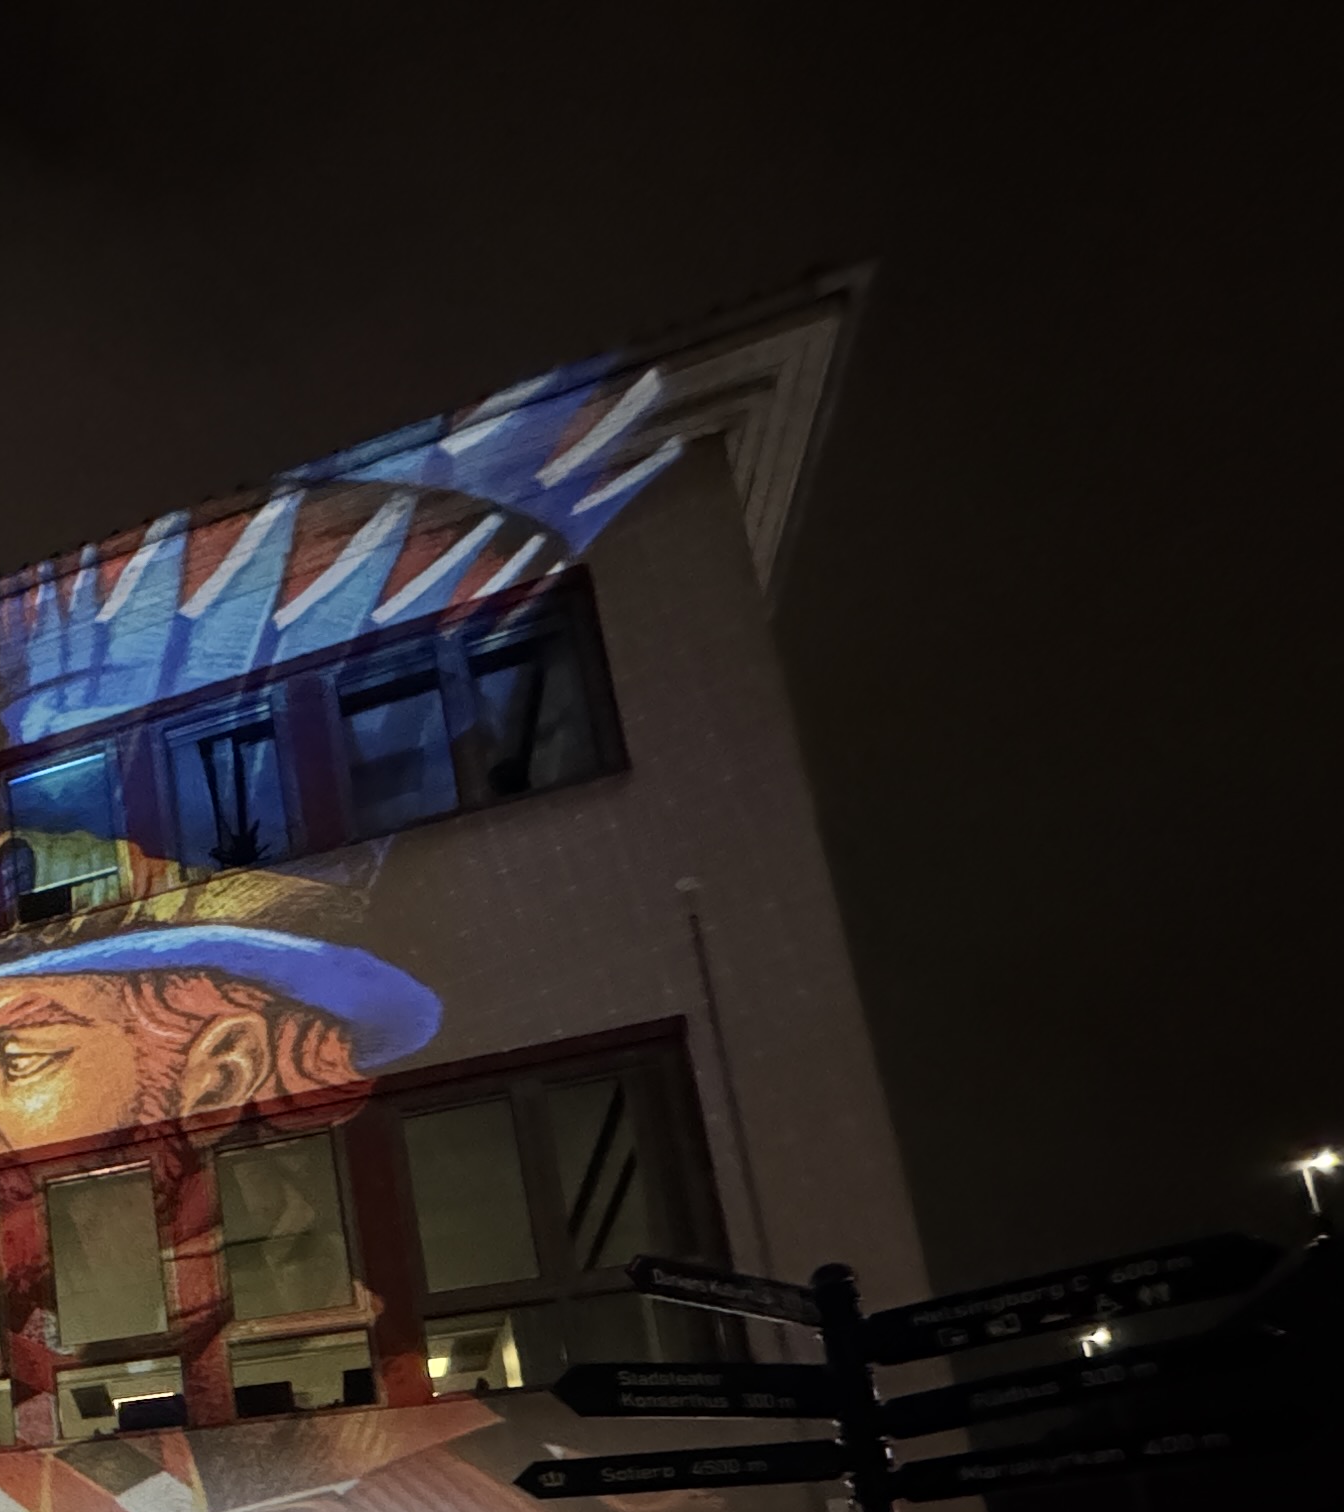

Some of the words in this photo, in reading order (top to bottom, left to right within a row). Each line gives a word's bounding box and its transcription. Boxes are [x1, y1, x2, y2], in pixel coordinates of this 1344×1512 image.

[911, 1282, 1065, 1326] Helsingborg
[619, 1392, 730, 1409] Konserthus
[599, 1465, 677, 1484] Sofiero
